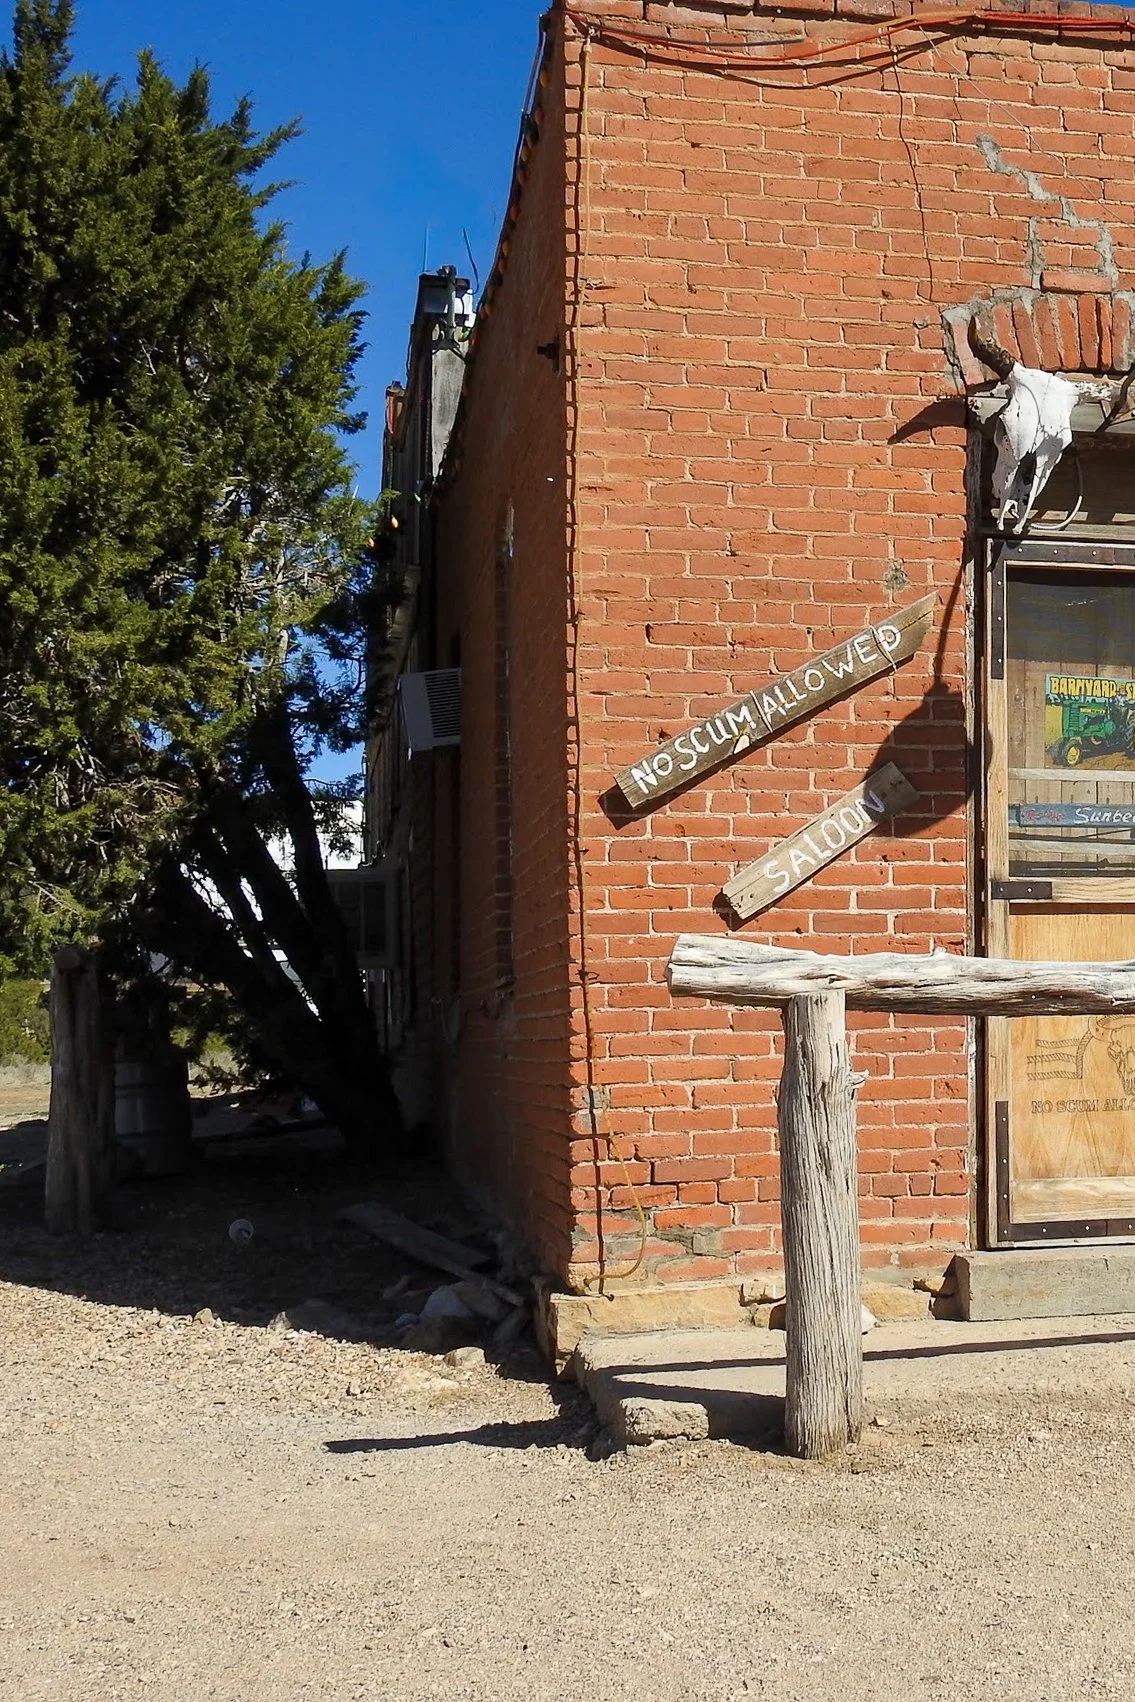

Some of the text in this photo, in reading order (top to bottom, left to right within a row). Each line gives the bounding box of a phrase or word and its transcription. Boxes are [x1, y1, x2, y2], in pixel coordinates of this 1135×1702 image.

[631, 624, 902, 794] NO SCUM ALLOWED
[1050, 677, 1116, 698] BARNYARD
[764, 791, 885, 892] SALOON
[1031, 1100, 1053, 1114] NO
[1057, 1099, 1099, 1113] SCUM
